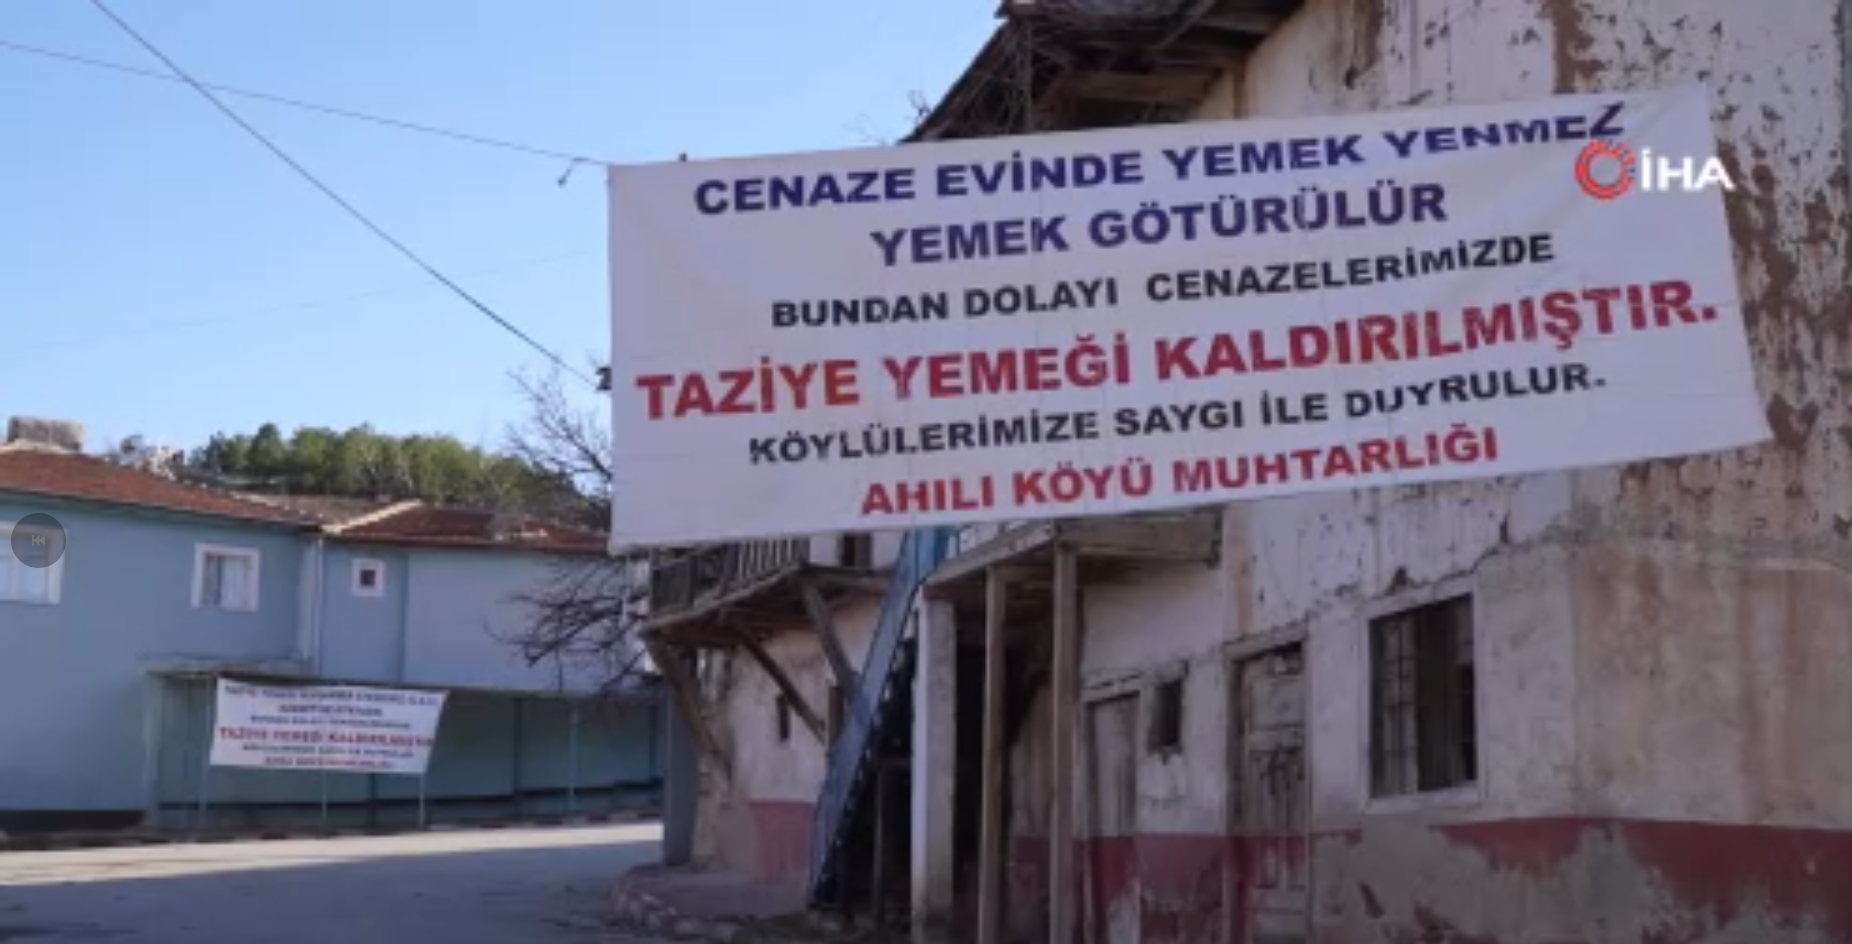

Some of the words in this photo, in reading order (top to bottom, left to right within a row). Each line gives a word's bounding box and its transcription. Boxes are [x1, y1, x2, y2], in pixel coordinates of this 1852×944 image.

[695, 169, 915, 215] CENAZE
[938, 149, 1142, 197] EVİNDE
[1163, 134, 1363, 180] YEMEK
[1383, 102, 1625, 158] YENMEZ
[871, 216, 1069, 267] YEMEK
[1088, 183, 1447, 248] GÖTÜRÜLÜR
[773, 292, 949, 328] BUNDAN
[965, 277, 1118, 316] DOLAYI
[1147, 234, 1554, 302] CENAZELERİMİZDE
[637, 356, 859, 419] TAZİYE
[883, 332, 1130, 400] YEMEĞİ
[1155, 280, 1718, 381] KALDIRILMIŞTIR.
[750, 409, 1098, 462] KÖYLÜLERİMİZE
[1114, 400, 1244, 436] SAYGI
[1261, 390, 1328, 425] İLE
[1346, 363, 1606, 418] DUYRULUR.
[861, 475, 993, 516] AHILI
[1014, 459, 1153, 506] KÖYÜ
[1173, 423, 1497, 493] MUHTARLIĞI
